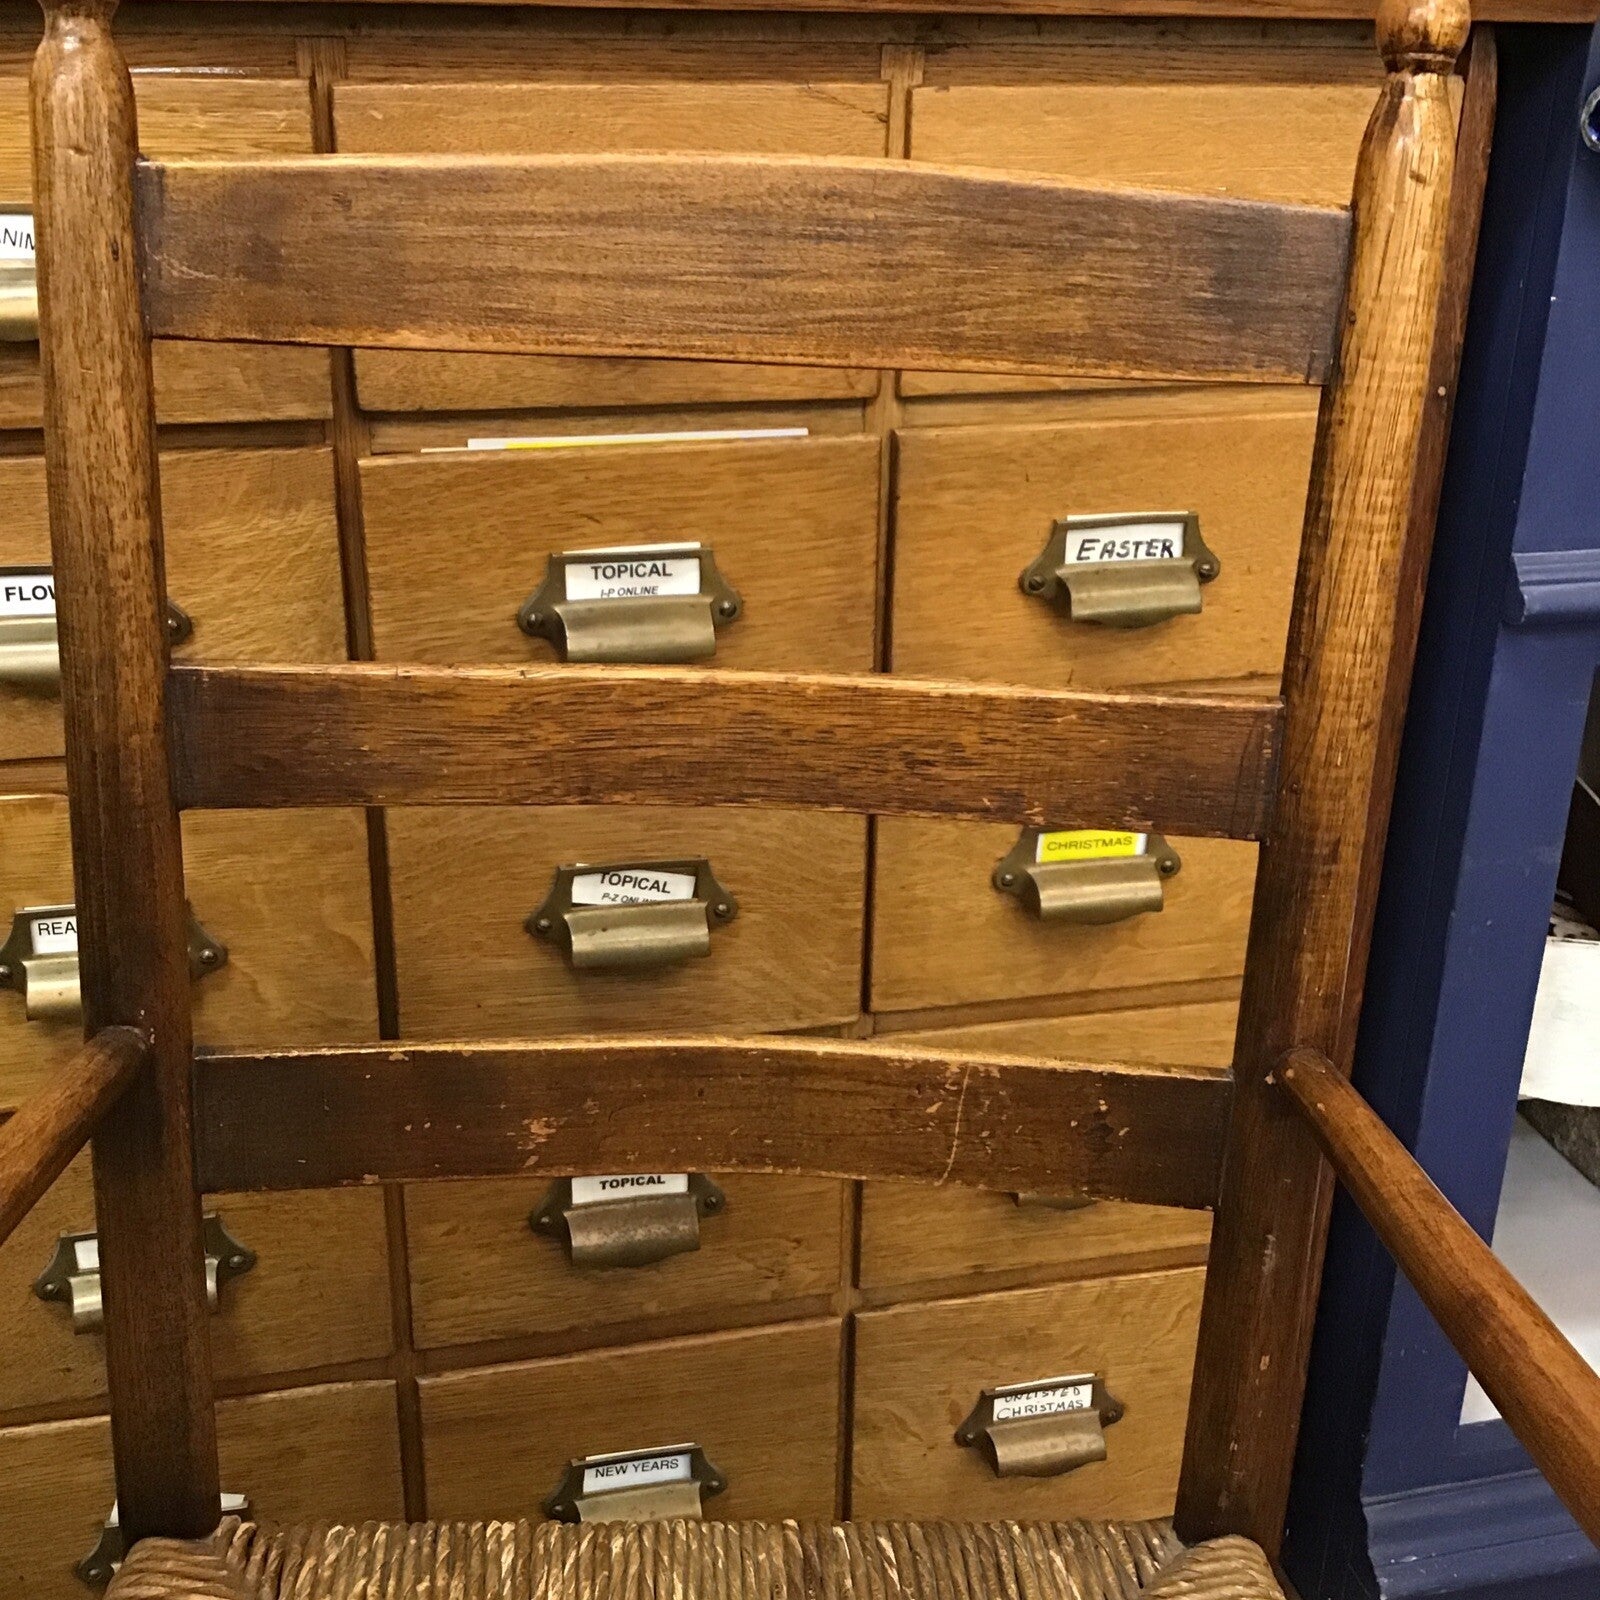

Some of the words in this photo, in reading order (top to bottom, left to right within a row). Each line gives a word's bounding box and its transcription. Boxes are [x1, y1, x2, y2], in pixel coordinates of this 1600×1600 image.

[1076, 538, 1174, 561] EASTER
[591, 563, 673, 580] TOPICAL
[617, 586, 659, 597] ONLINE
[1046, 836, 1133, 852] CHRISTMAS
[600, 873, 671, 893] TOPICAL
[601, 893, 619, 901] P-Z
[599, 1175, 666, 1190] TOPICAL
[997, 1400, 1084, 1420] CHRISTMAS
[595, 1464, 628, 1478] NEW
[632, 1459, 679, 1473] YEARS
